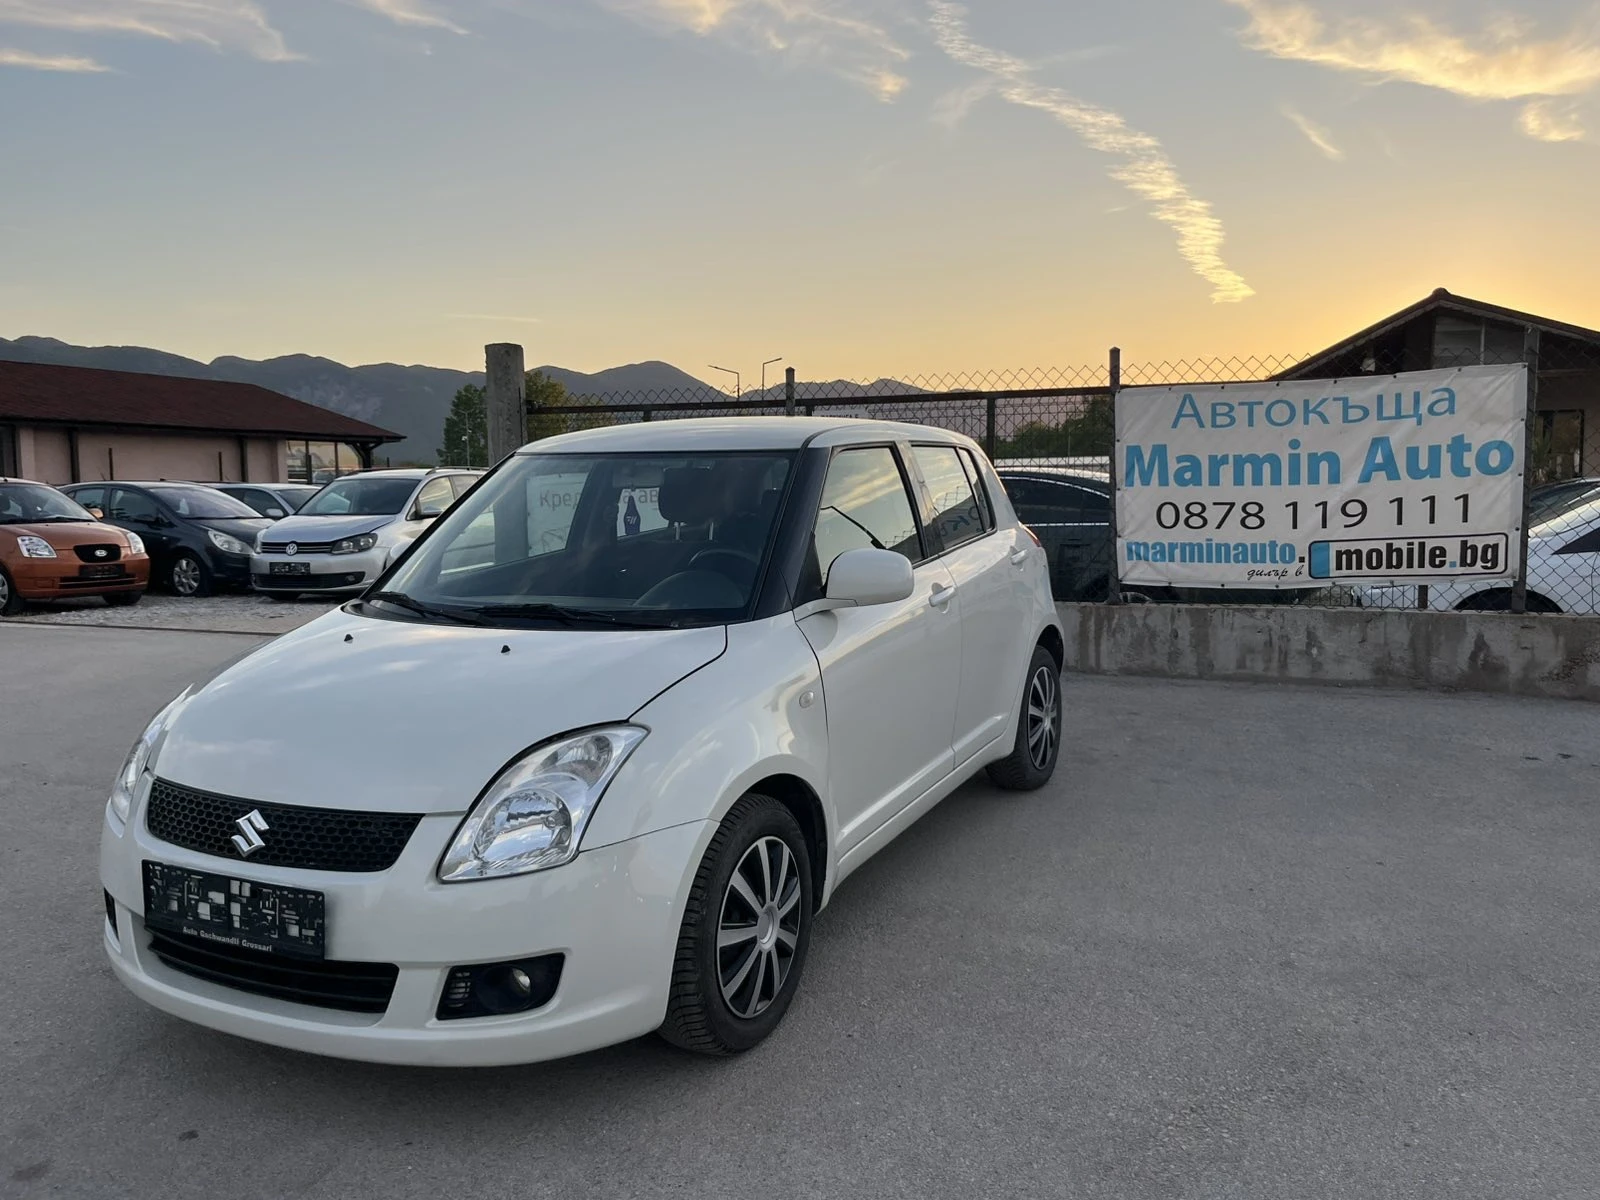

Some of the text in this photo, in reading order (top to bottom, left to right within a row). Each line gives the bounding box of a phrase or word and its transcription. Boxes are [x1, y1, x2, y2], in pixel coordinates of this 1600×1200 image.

[1170, 387, 1457, 429] Автокъща
[1124, 433, 1514, 487] Marmin Auto
[1156, 493, 1469, 530] 0878 119 111
[1335, 540, 1500, 571] mobile.bg
[1246, 567, 1288, 581] дилър
[182, 926, 198, 936] Auto
